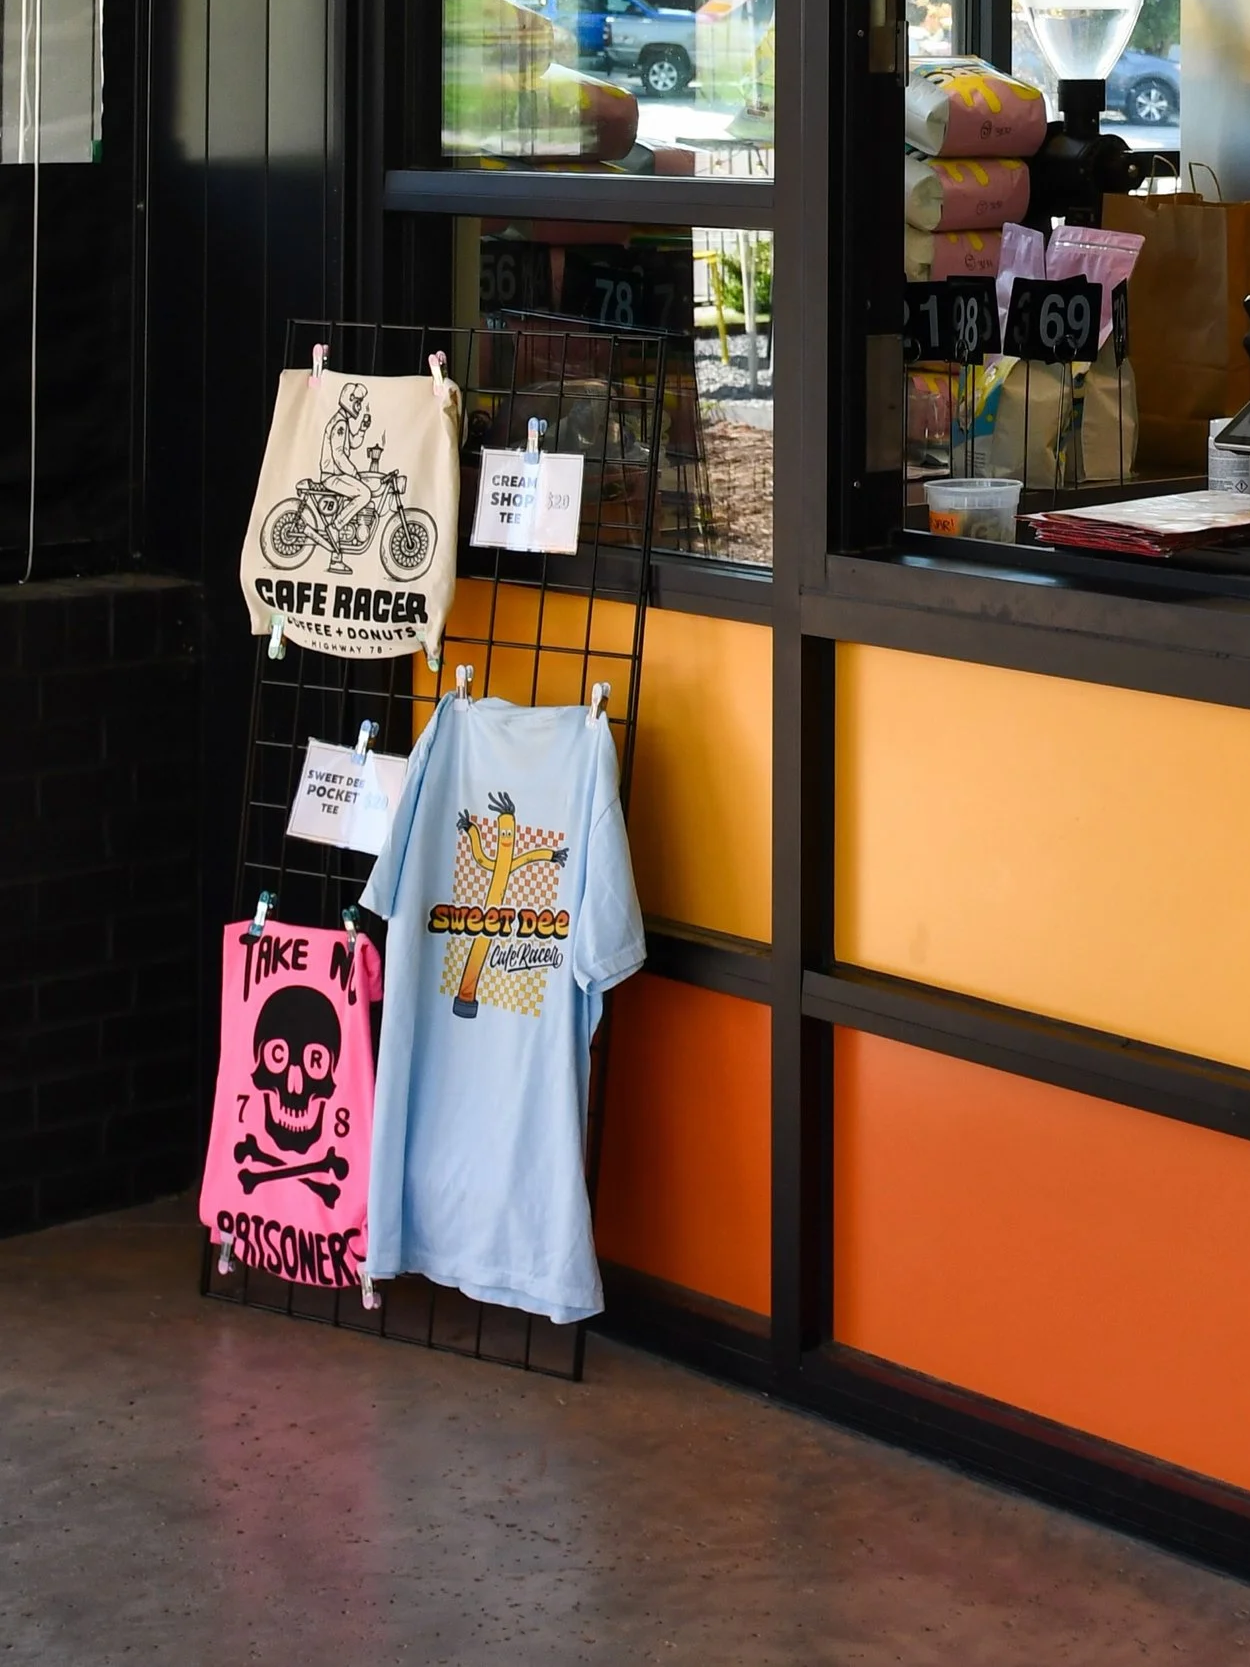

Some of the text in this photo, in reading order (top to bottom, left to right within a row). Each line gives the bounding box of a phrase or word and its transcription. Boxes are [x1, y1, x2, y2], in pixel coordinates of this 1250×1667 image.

[594, 277, 634, 327] 78
[952, 295, 978, 352] 98
[1039, 293, 1091, 349] 69
[491, 474, 537, 488] CREAM
[322, 500, 335, 511] 78
[490, 492, 570, 511] SHOP $20
[499, 512, 521, 525] TEE
[255, 577, 428, 624] CAFE RACER
[348, 626, 416, 642] DONUTS
[311, 640, 383, 655] HIGHWAY 78
[307, 769, 365, 789] SWEET DEE
[306, 783, 360, 804] POCKET
[321, 803, 340, 814] TEE
[239, 932, 309, 1003] TAKE
[271, 1044, 323, 1069] C R
[236, 1094, 350, 1138] 7 8
